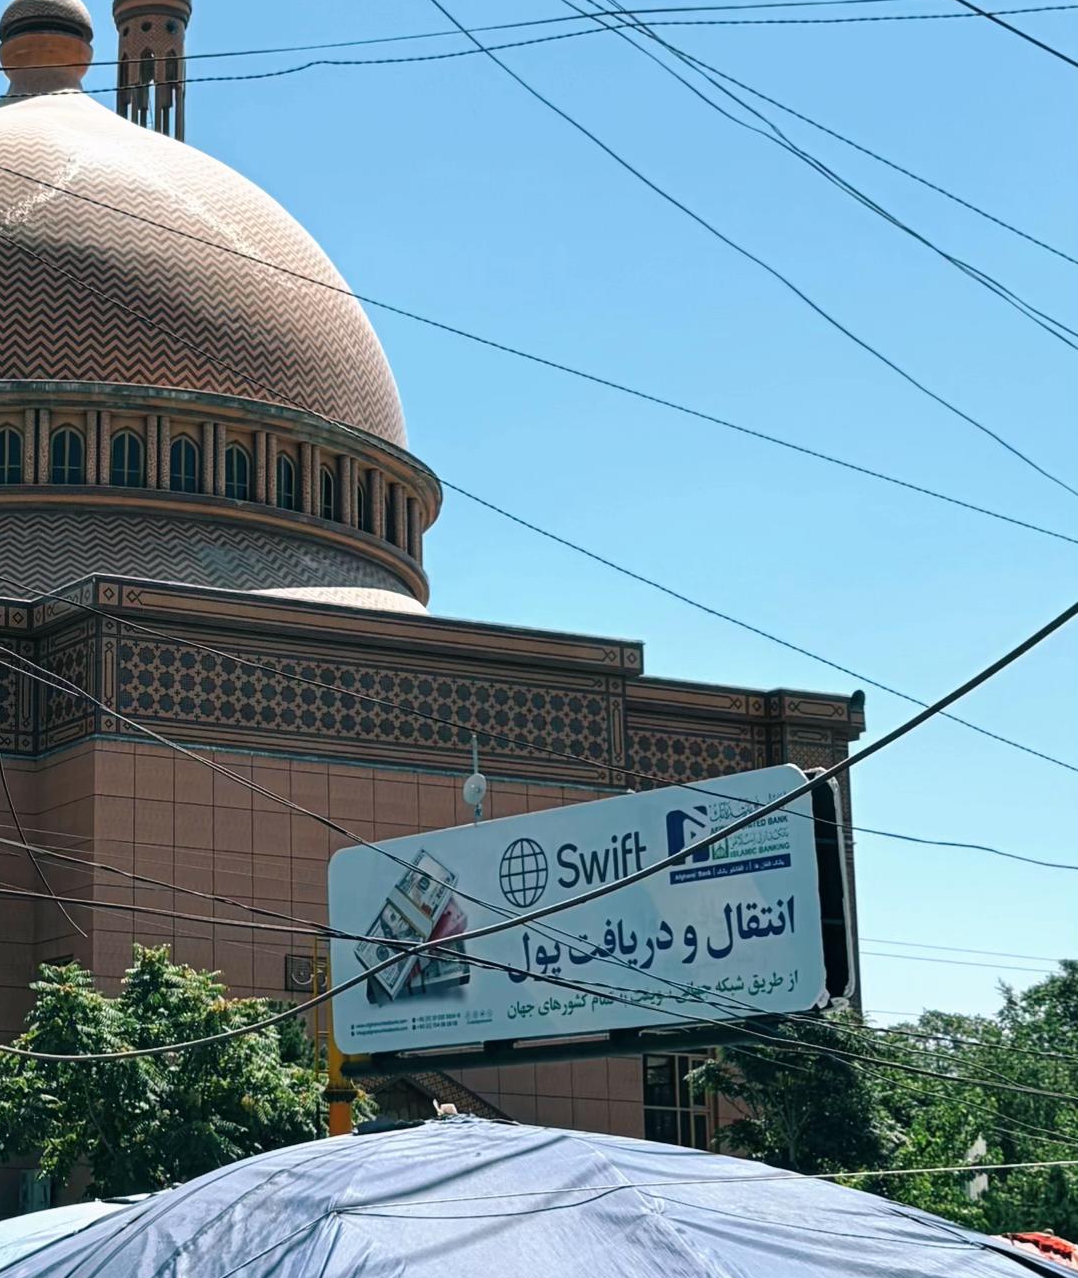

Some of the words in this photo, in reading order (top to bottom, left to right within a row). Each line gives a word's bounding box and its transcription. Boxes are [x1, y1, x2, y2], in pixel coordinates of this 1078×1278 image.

[556, 831, 647, 889] Swift
[759, 841, 790, 854] BANKING
[707, 895, 795, 959] انتقال
[506, 931, 562, 984] پول
[568, 919, 673, 969] دریافت
[681, 925, 698, 964] و
[716, 975, 745, 996] شبکه
[748, 971, 783, 996] طریق
[787, 970, 799, 992] از
[507, 1000, 535, 1019] جهان
